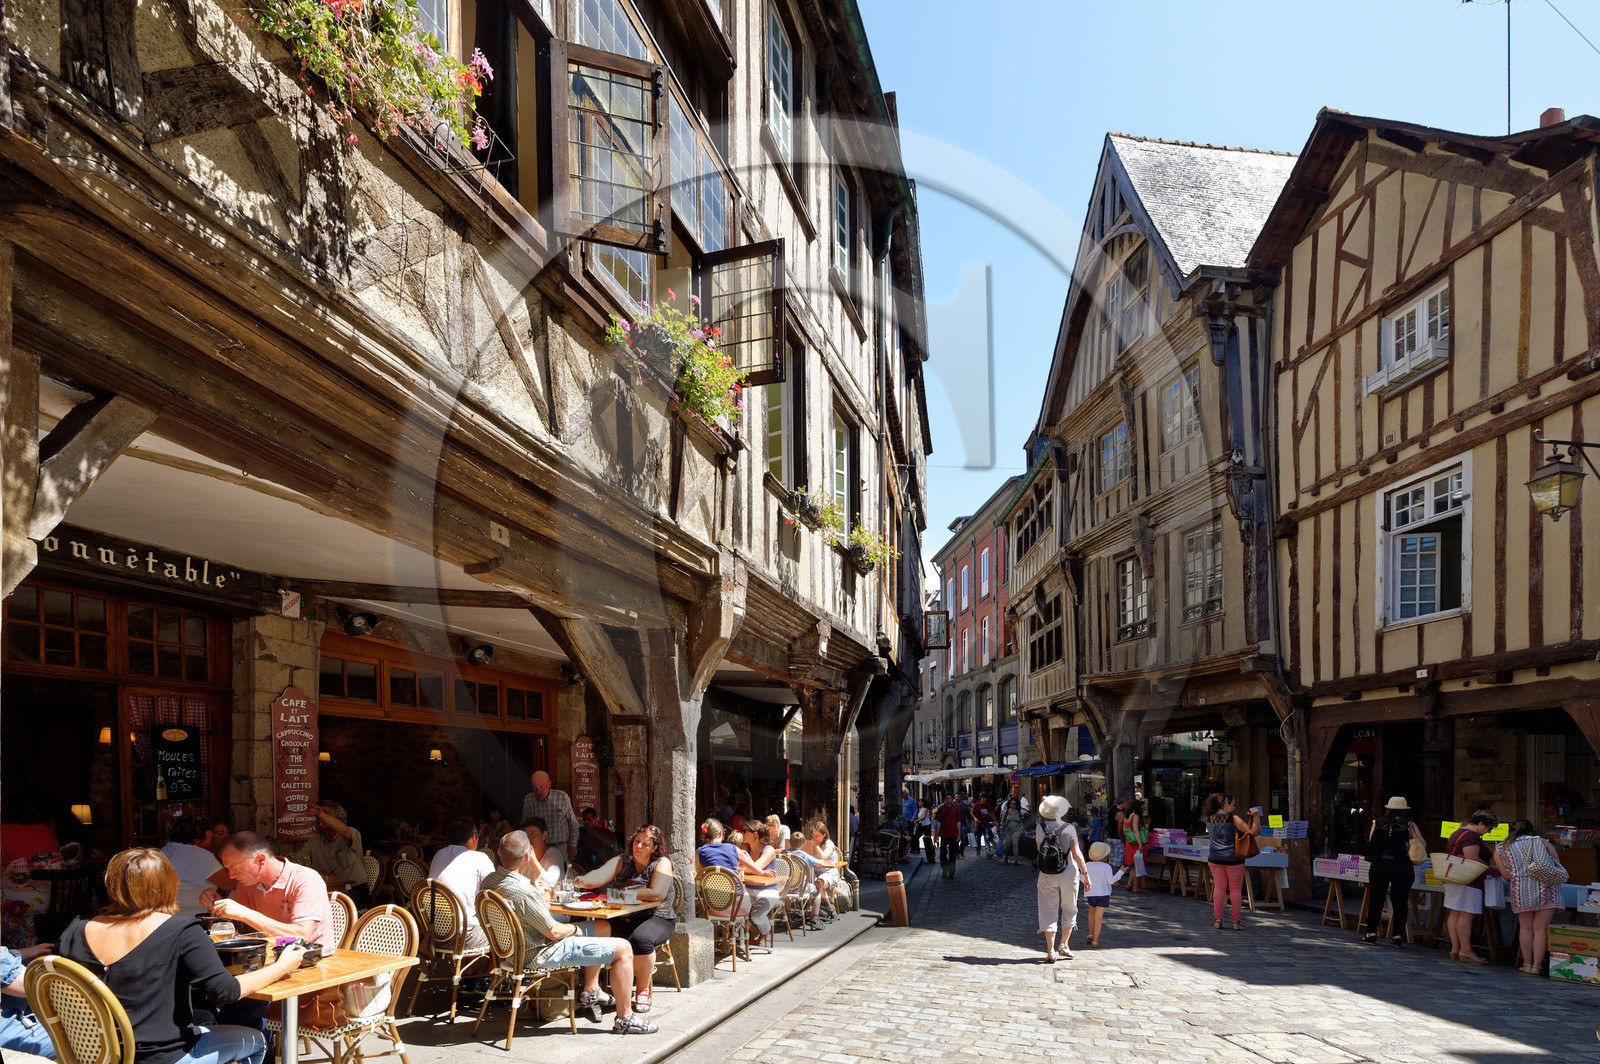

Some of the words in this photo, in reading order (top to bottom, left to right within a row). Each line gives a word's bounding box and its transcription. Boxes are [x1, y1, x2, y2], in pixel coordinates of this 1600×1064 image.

[281, 698, 307, 709] CAFE
[280, 712, 310, 723] LAIT
[276, 729, 314, 740] CAPPUCCINO
[158, 750, 194, 762] MOULES
[290, 755, 303, 763] THE
[285, 794, 309, 802] CIDRES
[287, 803, 308, 812] BIERES
